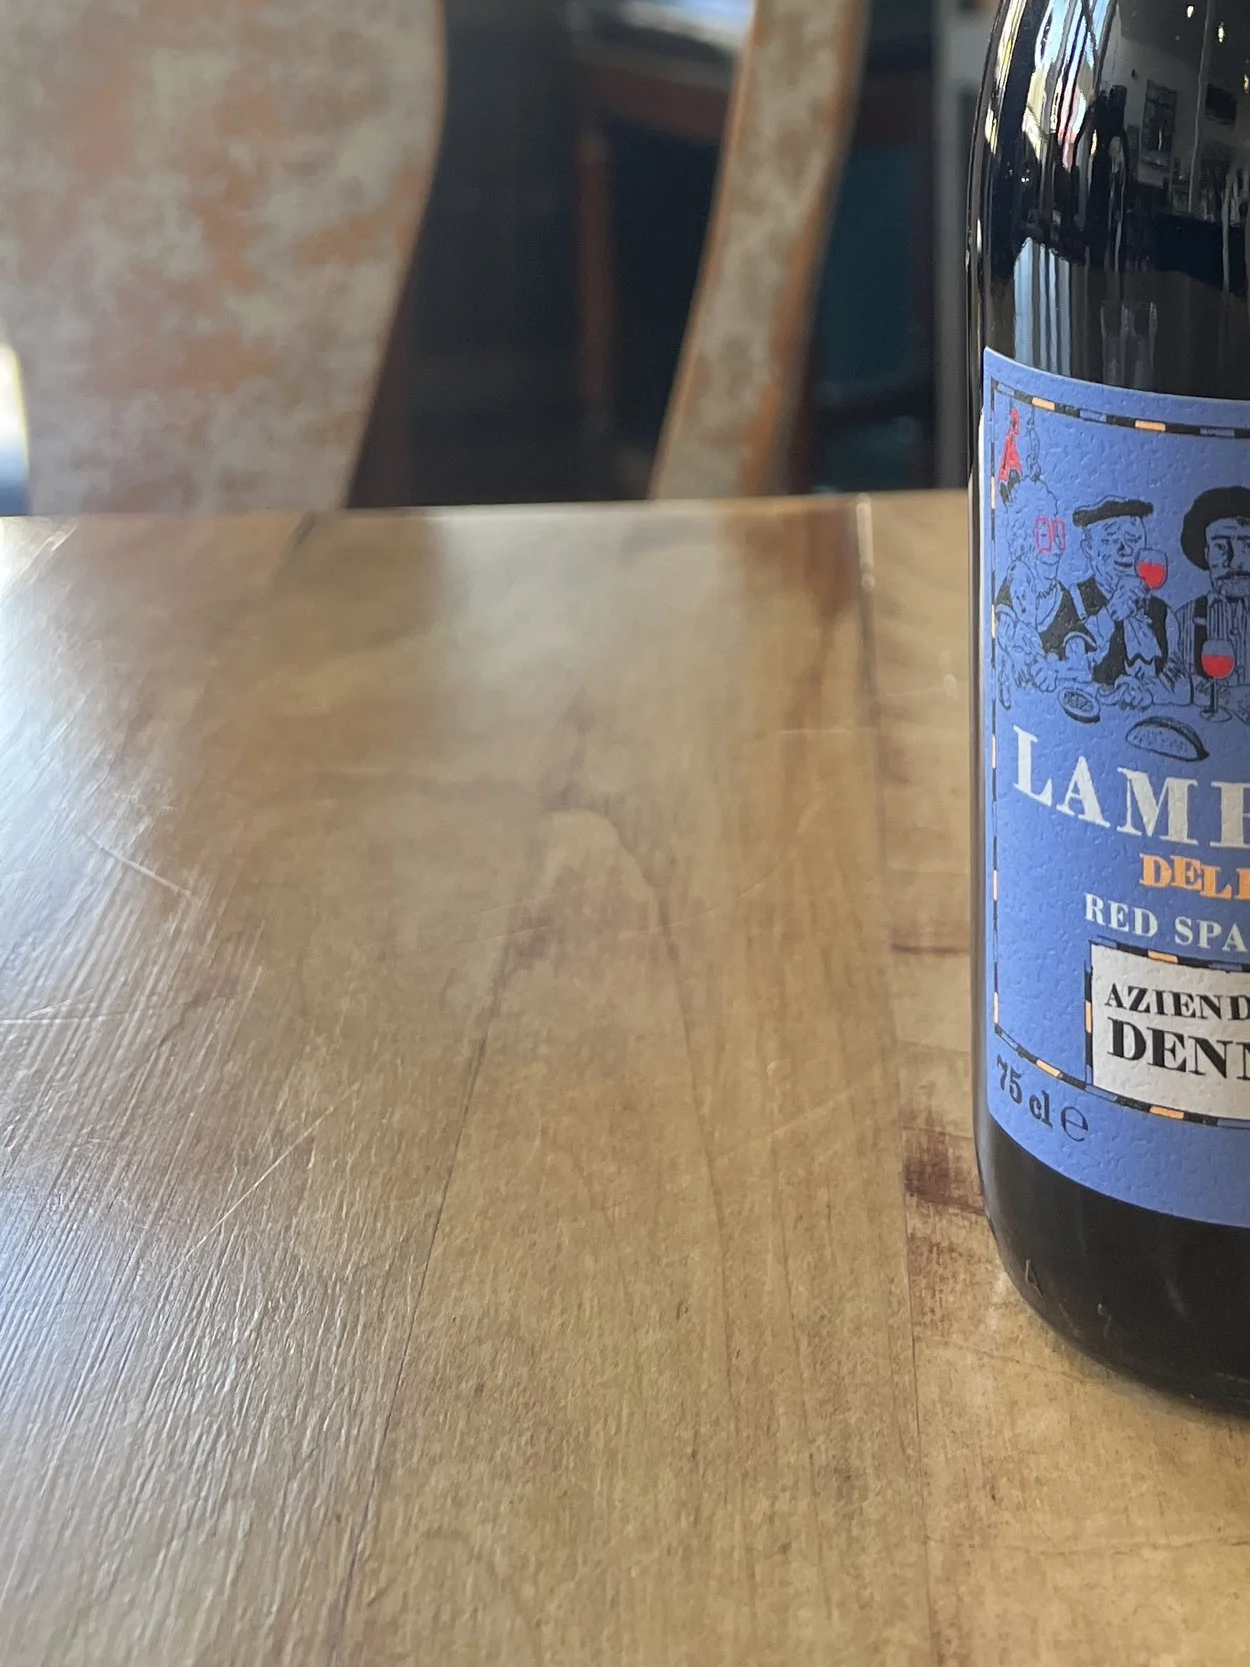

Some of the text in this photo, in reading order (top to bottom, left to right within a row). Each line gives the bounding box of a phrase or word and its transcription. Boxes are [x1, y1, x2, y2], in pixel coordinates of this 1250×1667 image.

[1084, 892, 1158, 939] RED
[997, 1054, 1022, 1104] 75
[1029, 1089, 1053, 1128] cl
